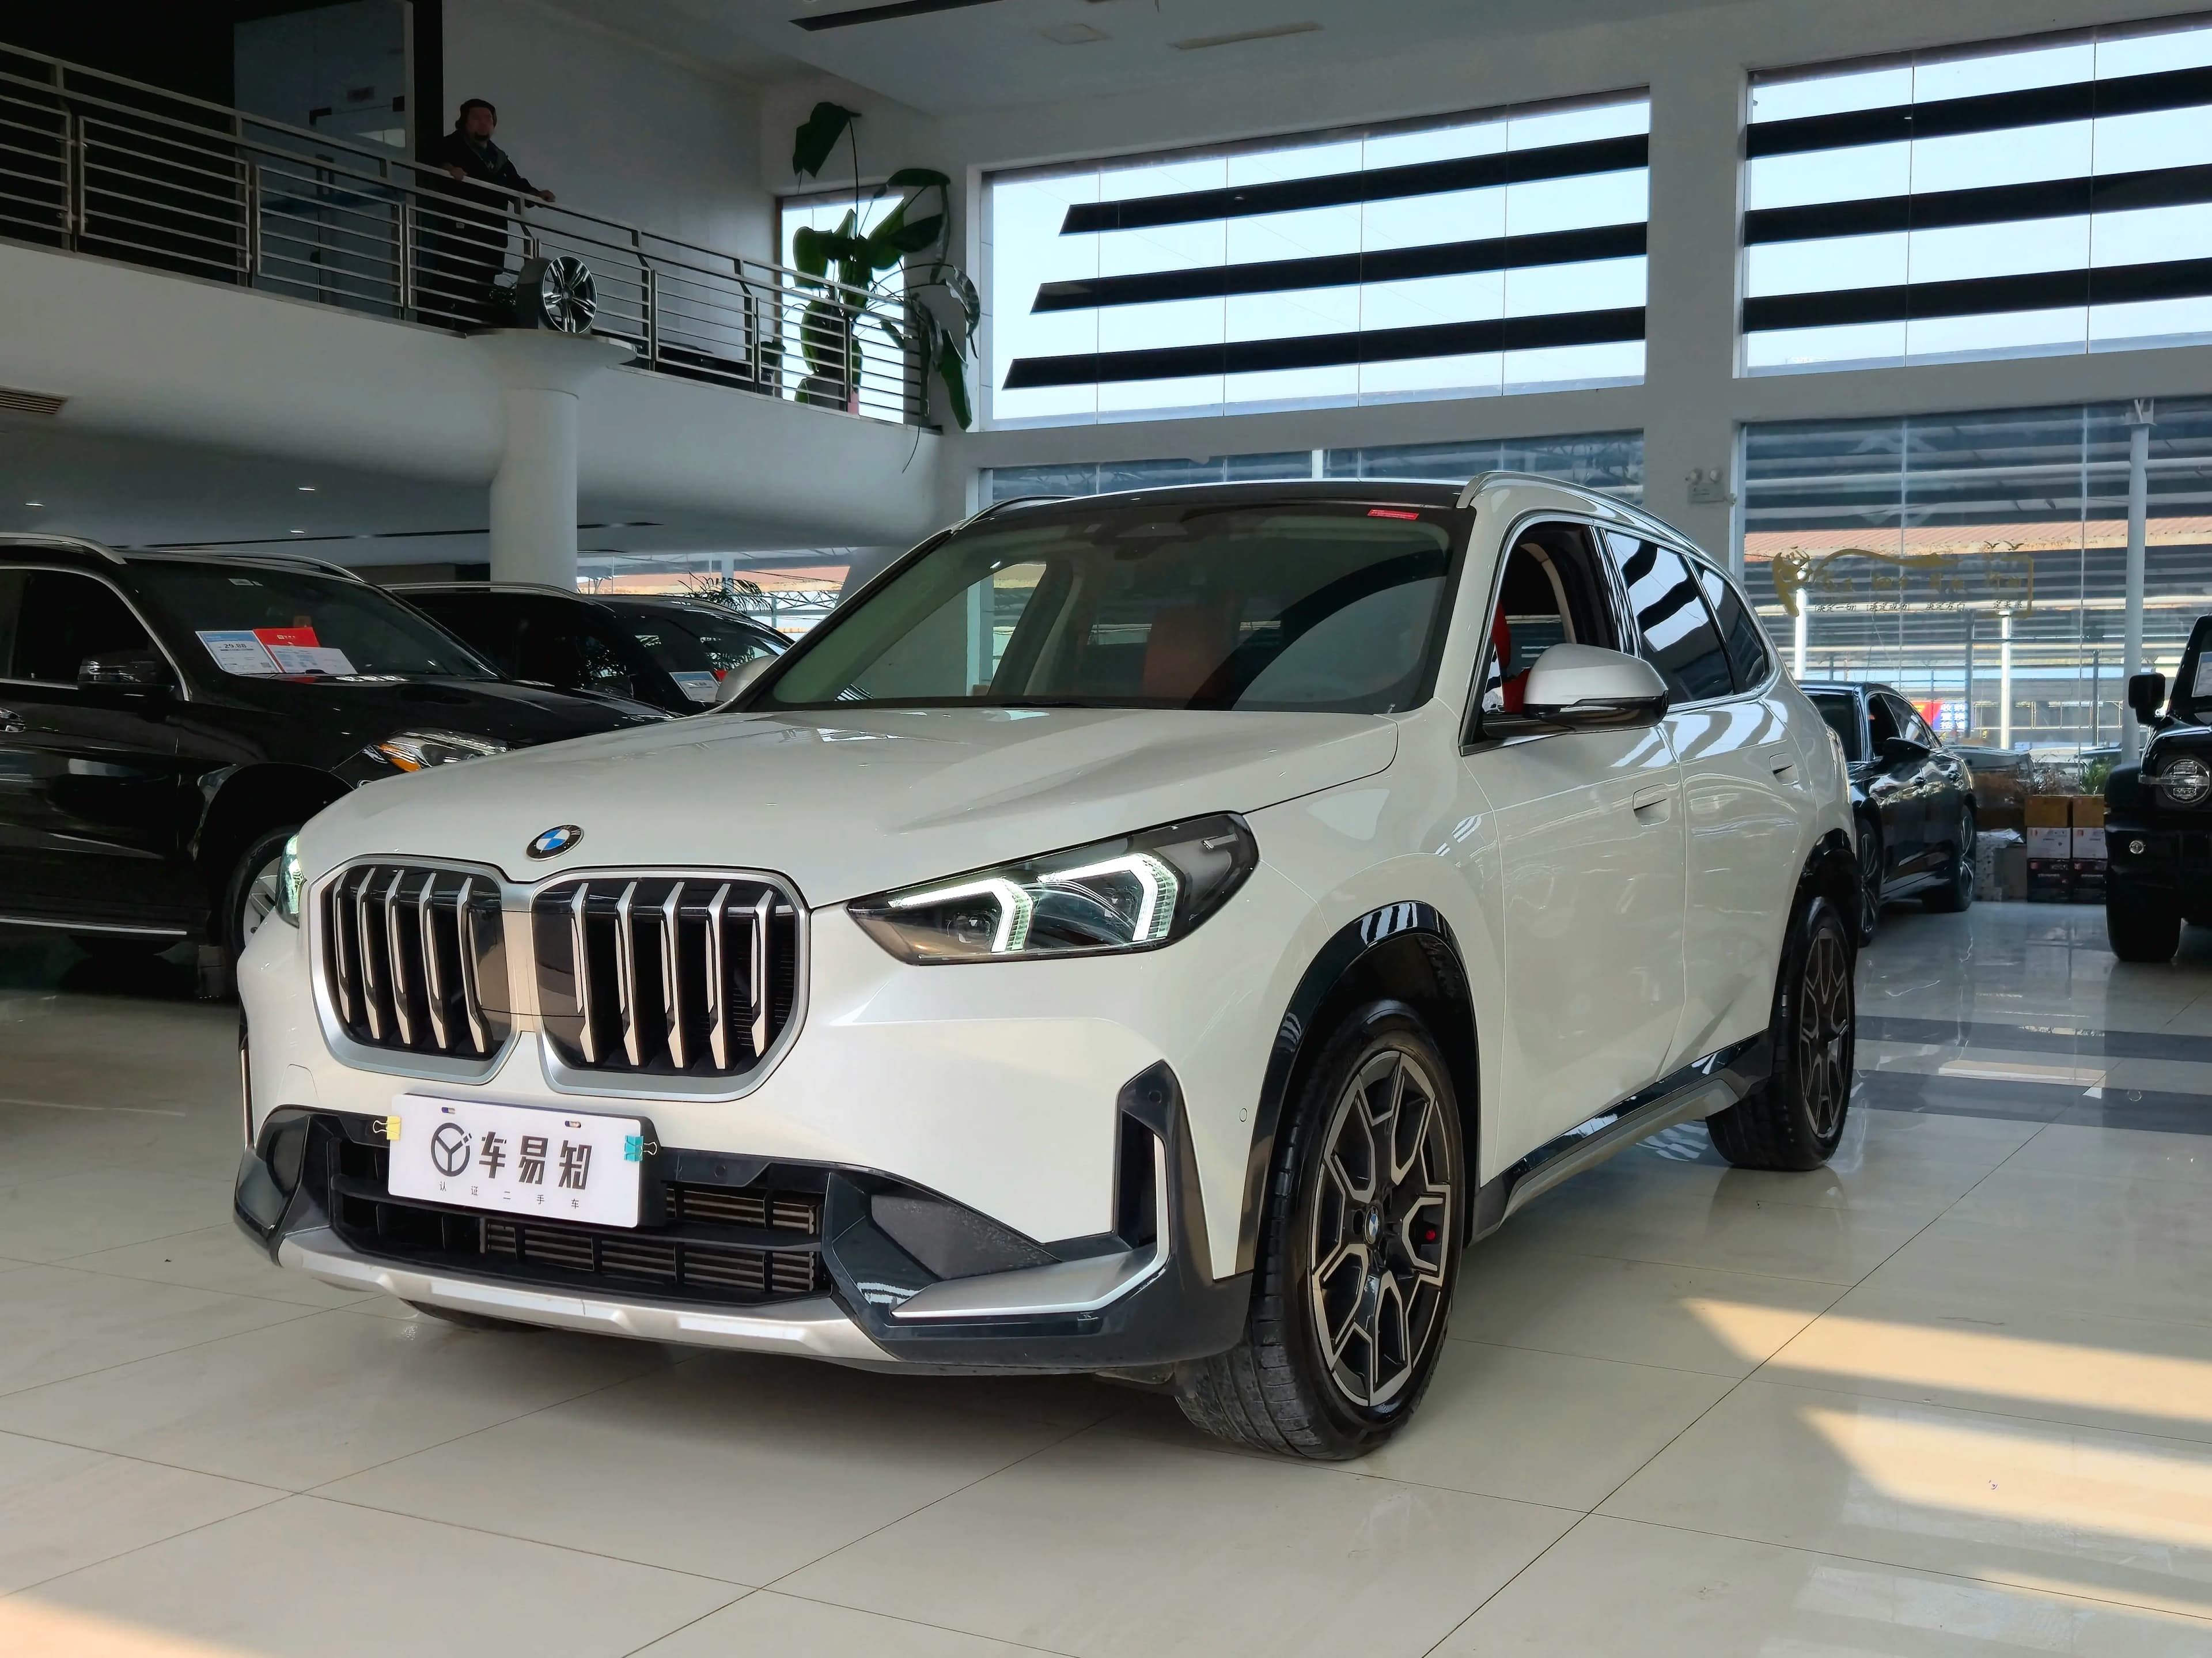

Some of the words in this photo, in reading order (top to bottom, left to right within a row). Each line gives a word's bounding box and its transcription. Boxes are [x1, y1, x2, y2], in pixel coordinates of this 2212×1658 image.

[479, 1131, 593, 1190] 车易知
[439, 1180, 579, 1209] 认证二手车
